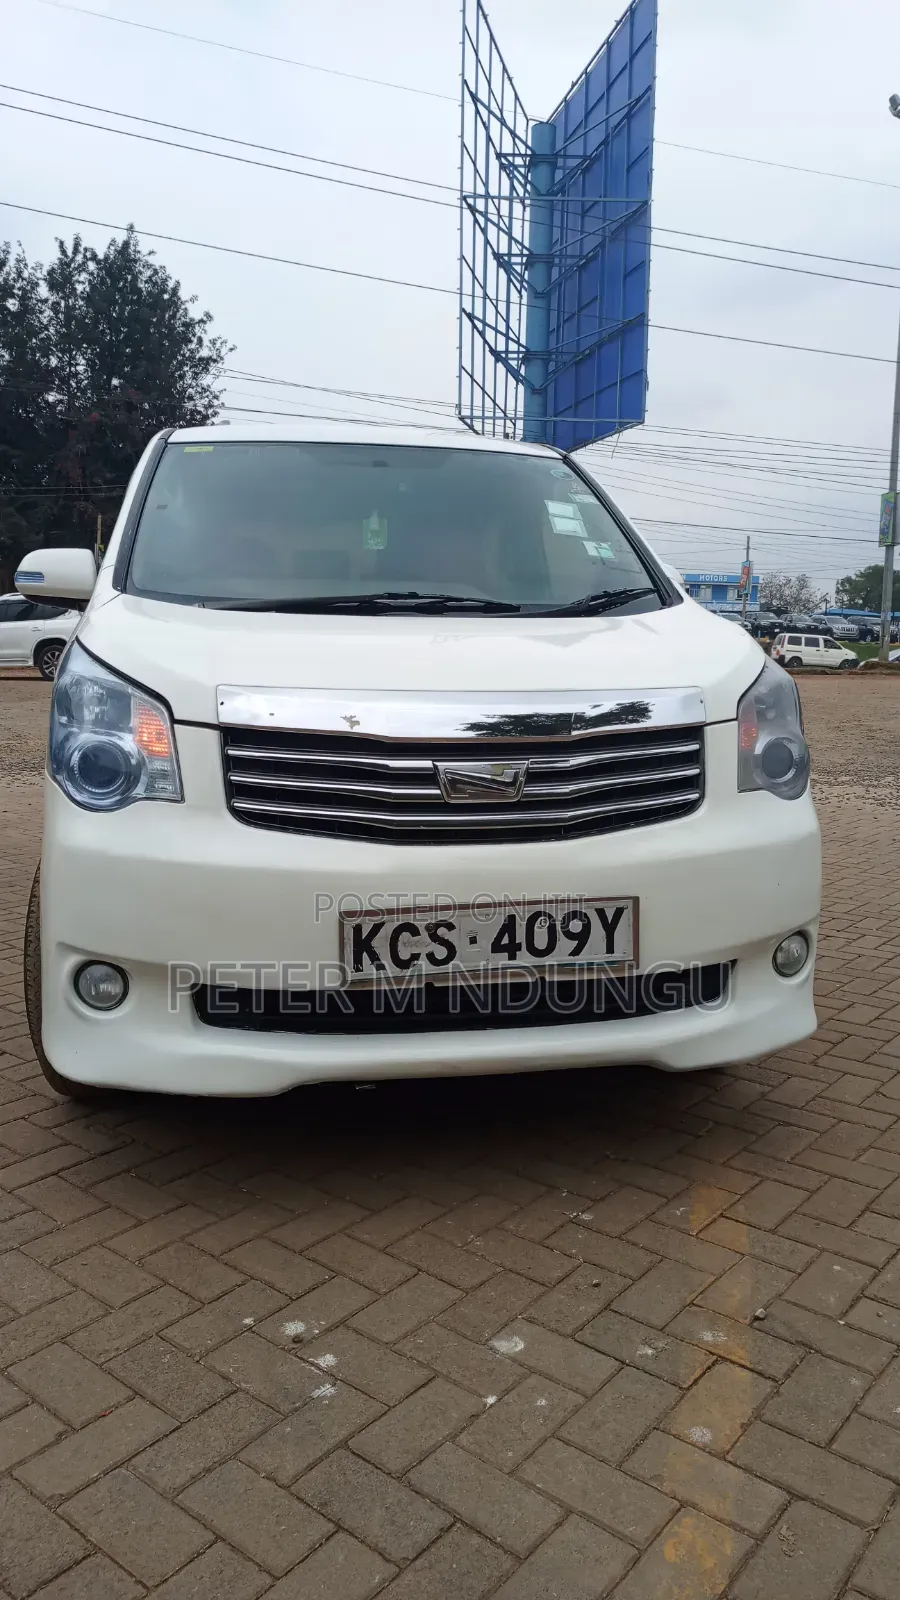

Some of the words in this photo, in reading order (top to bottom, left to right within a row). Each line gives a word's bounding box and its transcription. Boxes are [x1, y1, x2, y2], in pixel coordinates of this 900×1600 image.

[700, 574, 728, 582] MOTORS
[352, 919, 457, 973] KCS
[491, 906, 625, 961] 409Y
